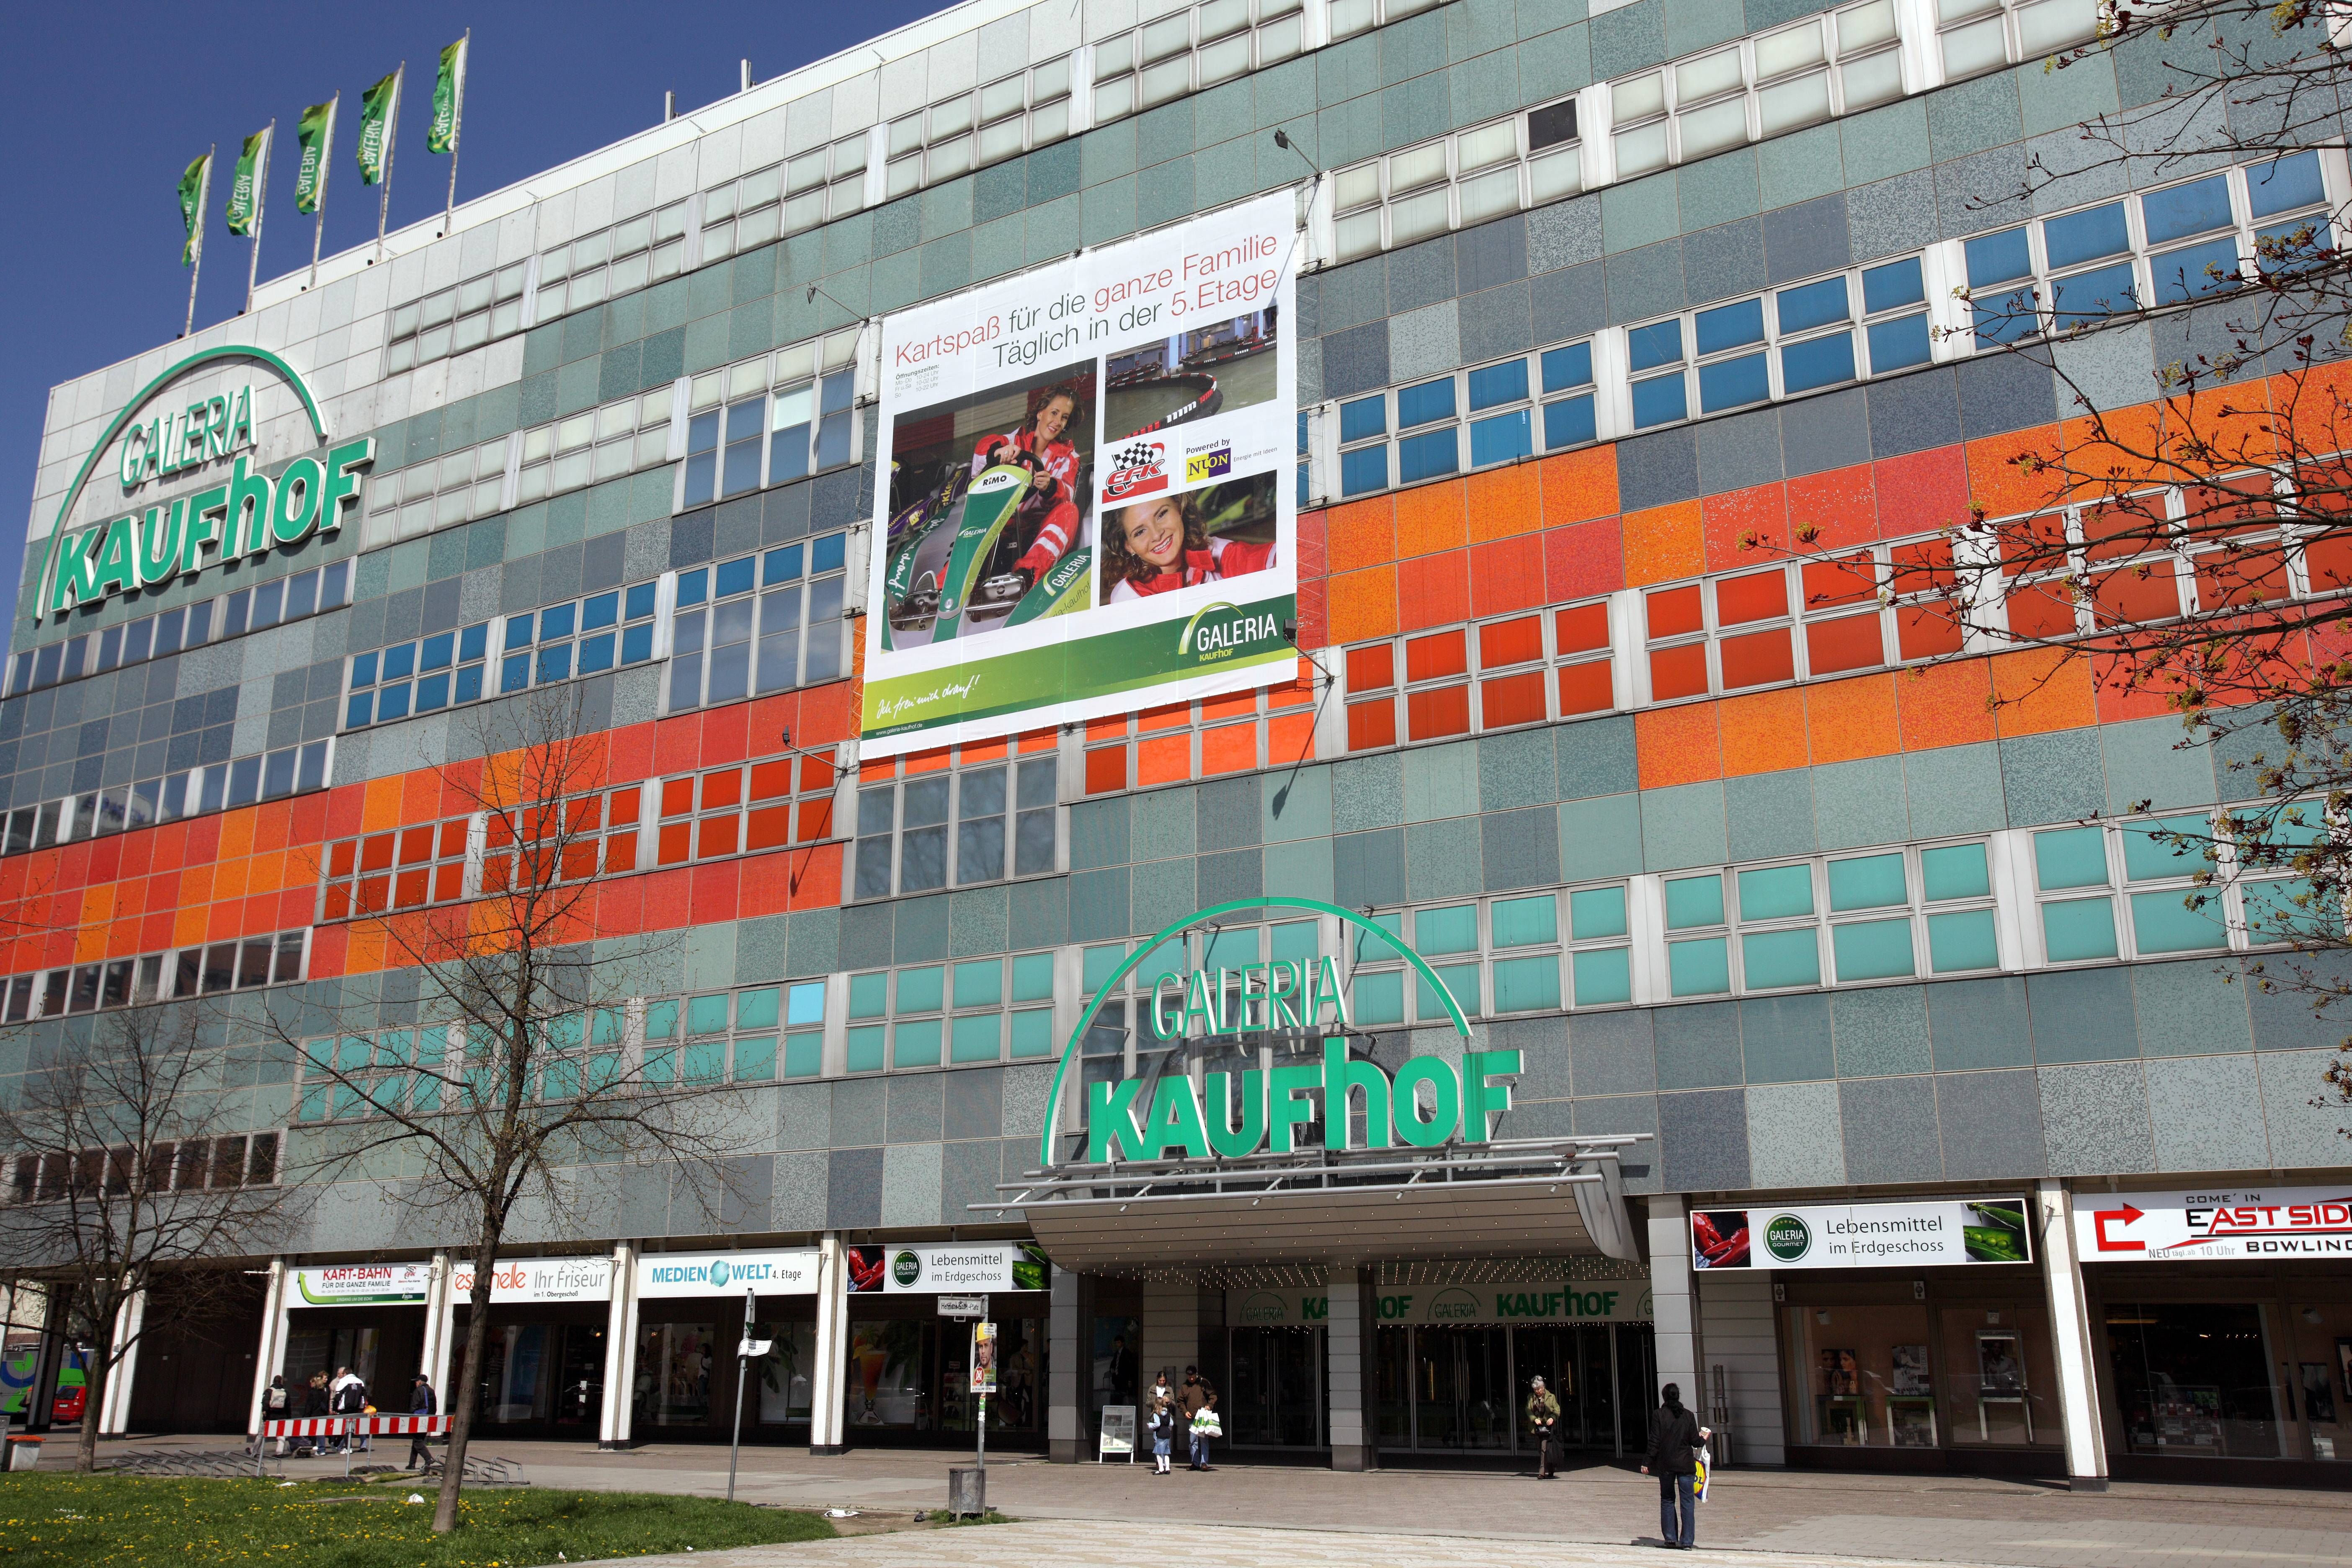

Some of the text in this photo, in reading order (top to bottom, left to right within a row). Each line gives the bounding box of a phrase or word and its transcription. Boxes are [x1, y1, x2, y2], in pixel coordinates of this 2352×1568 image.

[896, 235, 1277, 367] Kartspaß für die ganze Familie
[993, 324, 1078, 367] Täglich
[1089, 317, 1109, 340] in
[1119, 303, 1162, 331] der
[896, 364, 939, 380] Öffnungszeiten:
[120, 384, 257, 488] GALERIA
[1186, 438, 1230, 455] Powered by
[1233, 454, 1252, 462] Energie
[1263, 447, 1278, 455] Ideen
[1189, 453, 1229, 477] NUON
[963, 528, 987, 536] GALERIA
[1052, 555, 1091, 587] GALERIA
[1197, 613, 1277, 652] GALERIA
[877, 699, 891, 719] Ich
[876, 723, 923, 736] www.galeria-kaufhof.de
[1150, 955, 1349, 1041] GALERIA
[1826, 1215, 1942, 1234] Lebensmittel
[2185, 1204, 2352, 1235] EAST SID
[1770, 1229, 1805, 1241] GALERIA
[1829, 1239, 1944, 1256] im Erdgeschoss
[2148, 1248, 2170, 1258] NEU
[2200, 1246, 2213, 1256] 10
[2216, 1246, 2235, 1256] Uhr
[896, 1261, 918, 1270] GALERIA
[931, 1253, 1002, 1266] Lebensmittel
[323, 1267, 392, 1281] KART-BAHN
[534, 1270, 554, 1289] Ihr
[557, 1270, 605, 1288] Friseur
[652, 1266, 707, 1283] MEDIEN
[732, 1264, 772, 1280] WELT
[781, 1270, 801, 1281] Etage
[932, 1271, 1001, 1284] im Erdgeschoss
[1246, 1306, 1284, 1321] GALERIA
[1435, 1302, 1477, 1318] GALERIA
